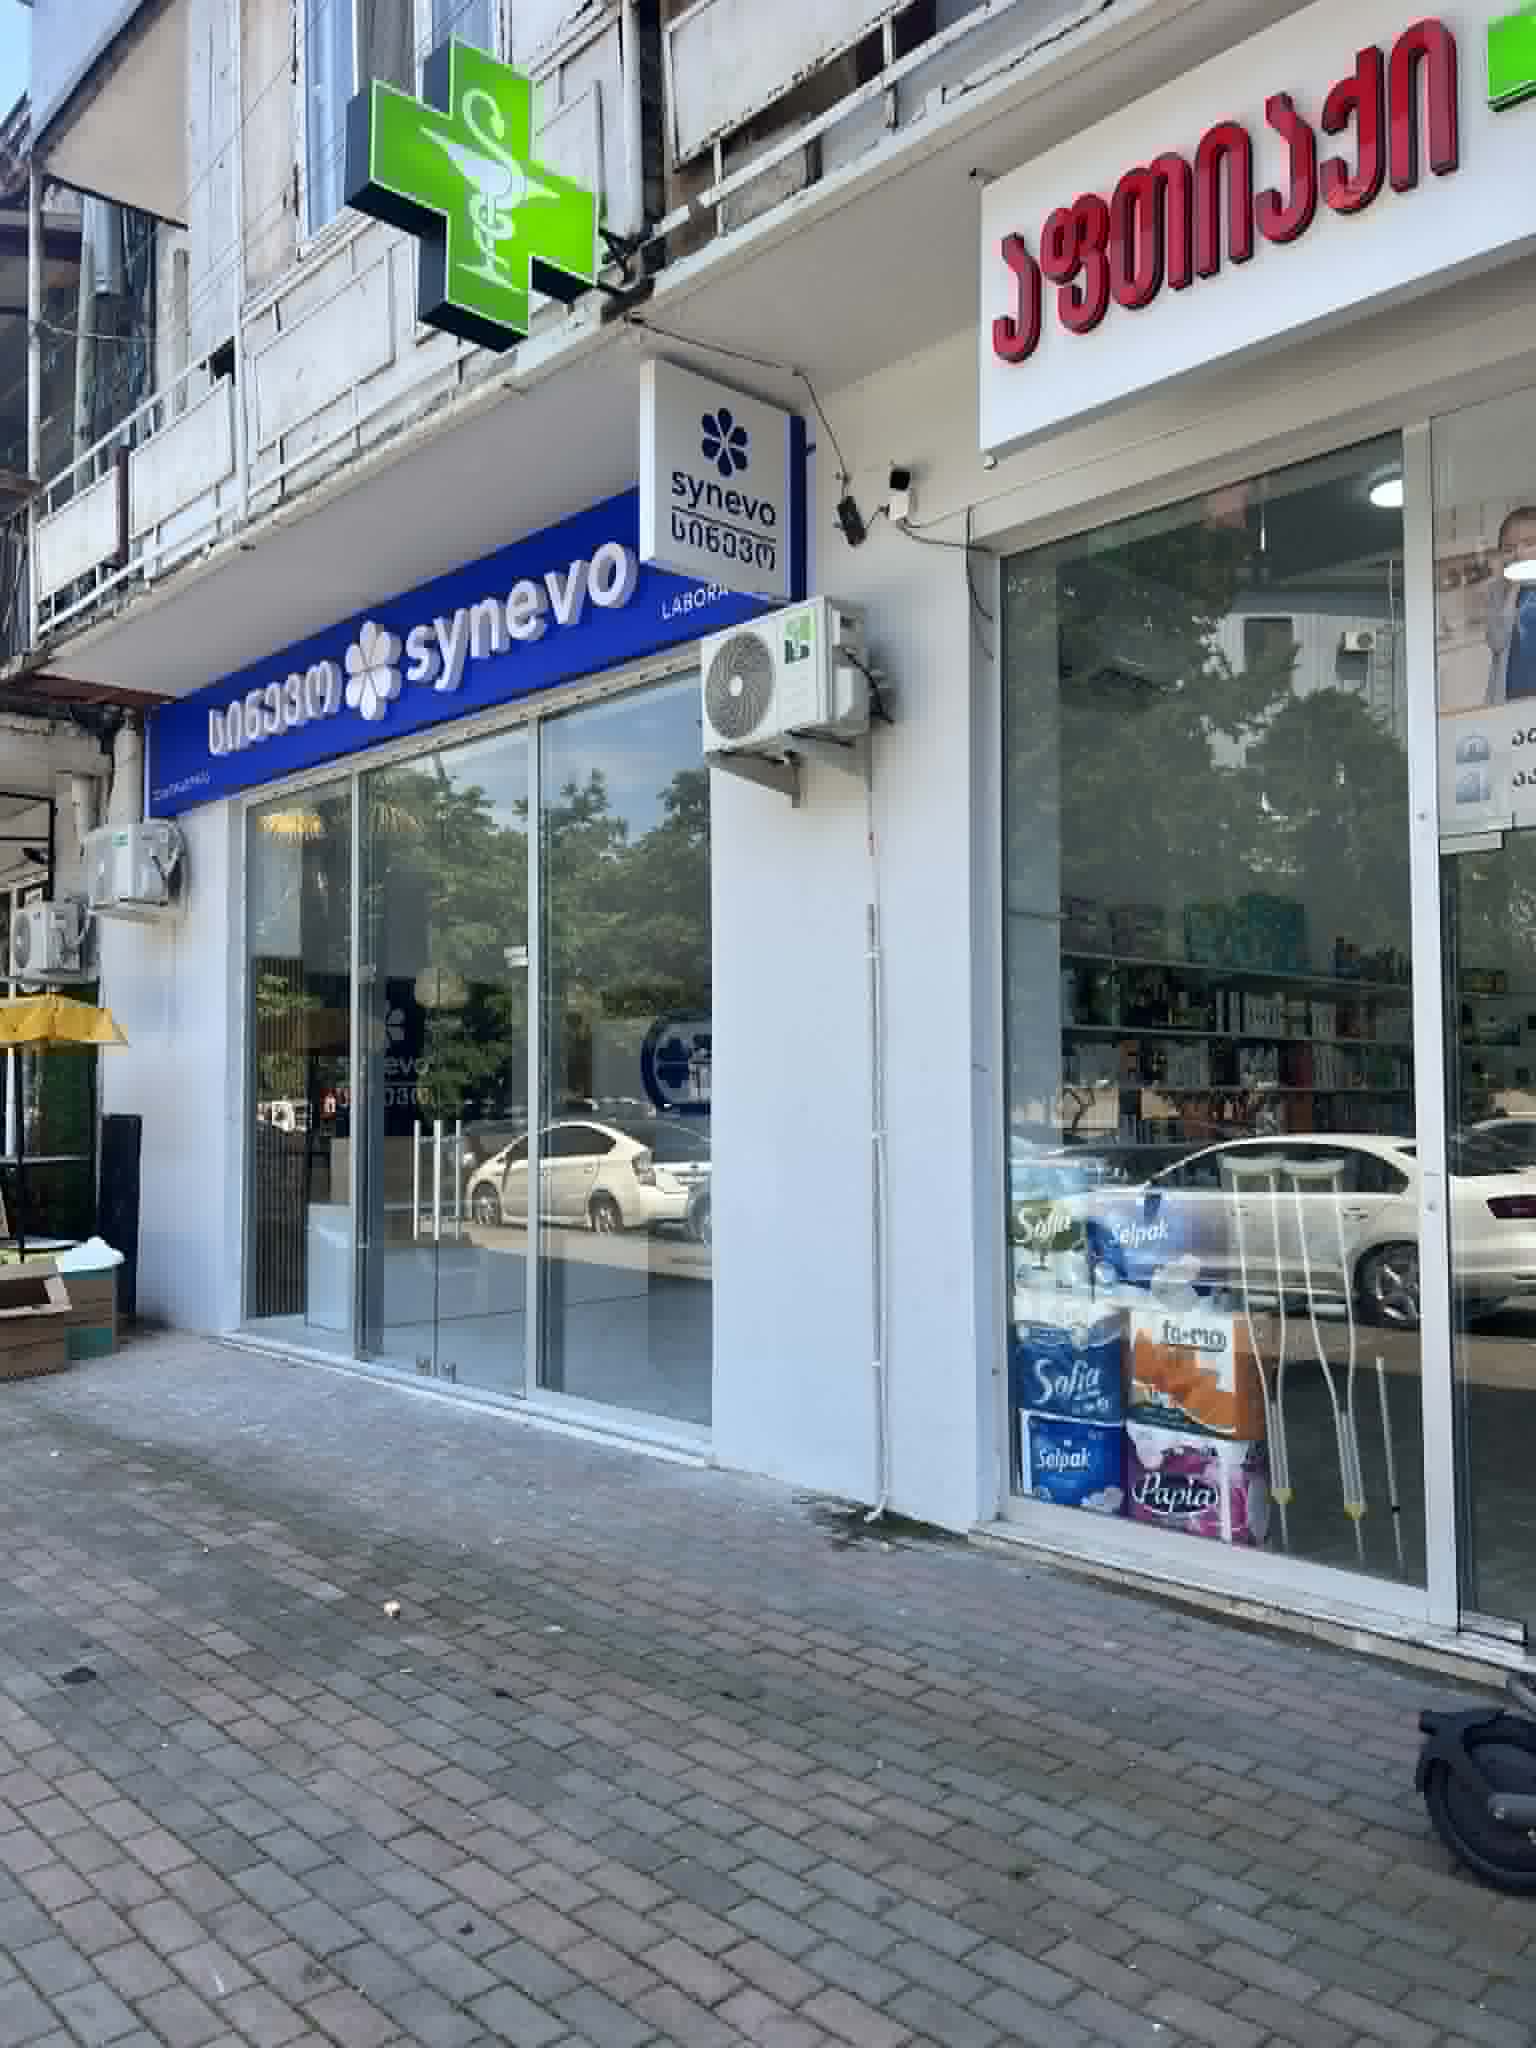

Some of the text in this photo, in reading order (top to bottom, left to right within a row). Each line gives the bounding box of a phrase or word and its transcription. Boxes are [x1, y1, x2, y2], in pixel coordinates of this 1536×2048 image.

[993, 17, 1458, 364] აფთიაქი
[671, 471, 776, 527] synevo
[671, 512, 776, 571] სინევო
[406, 541, 639, 692] synevo
[1132, 1472, 1218, 1513] Papia
